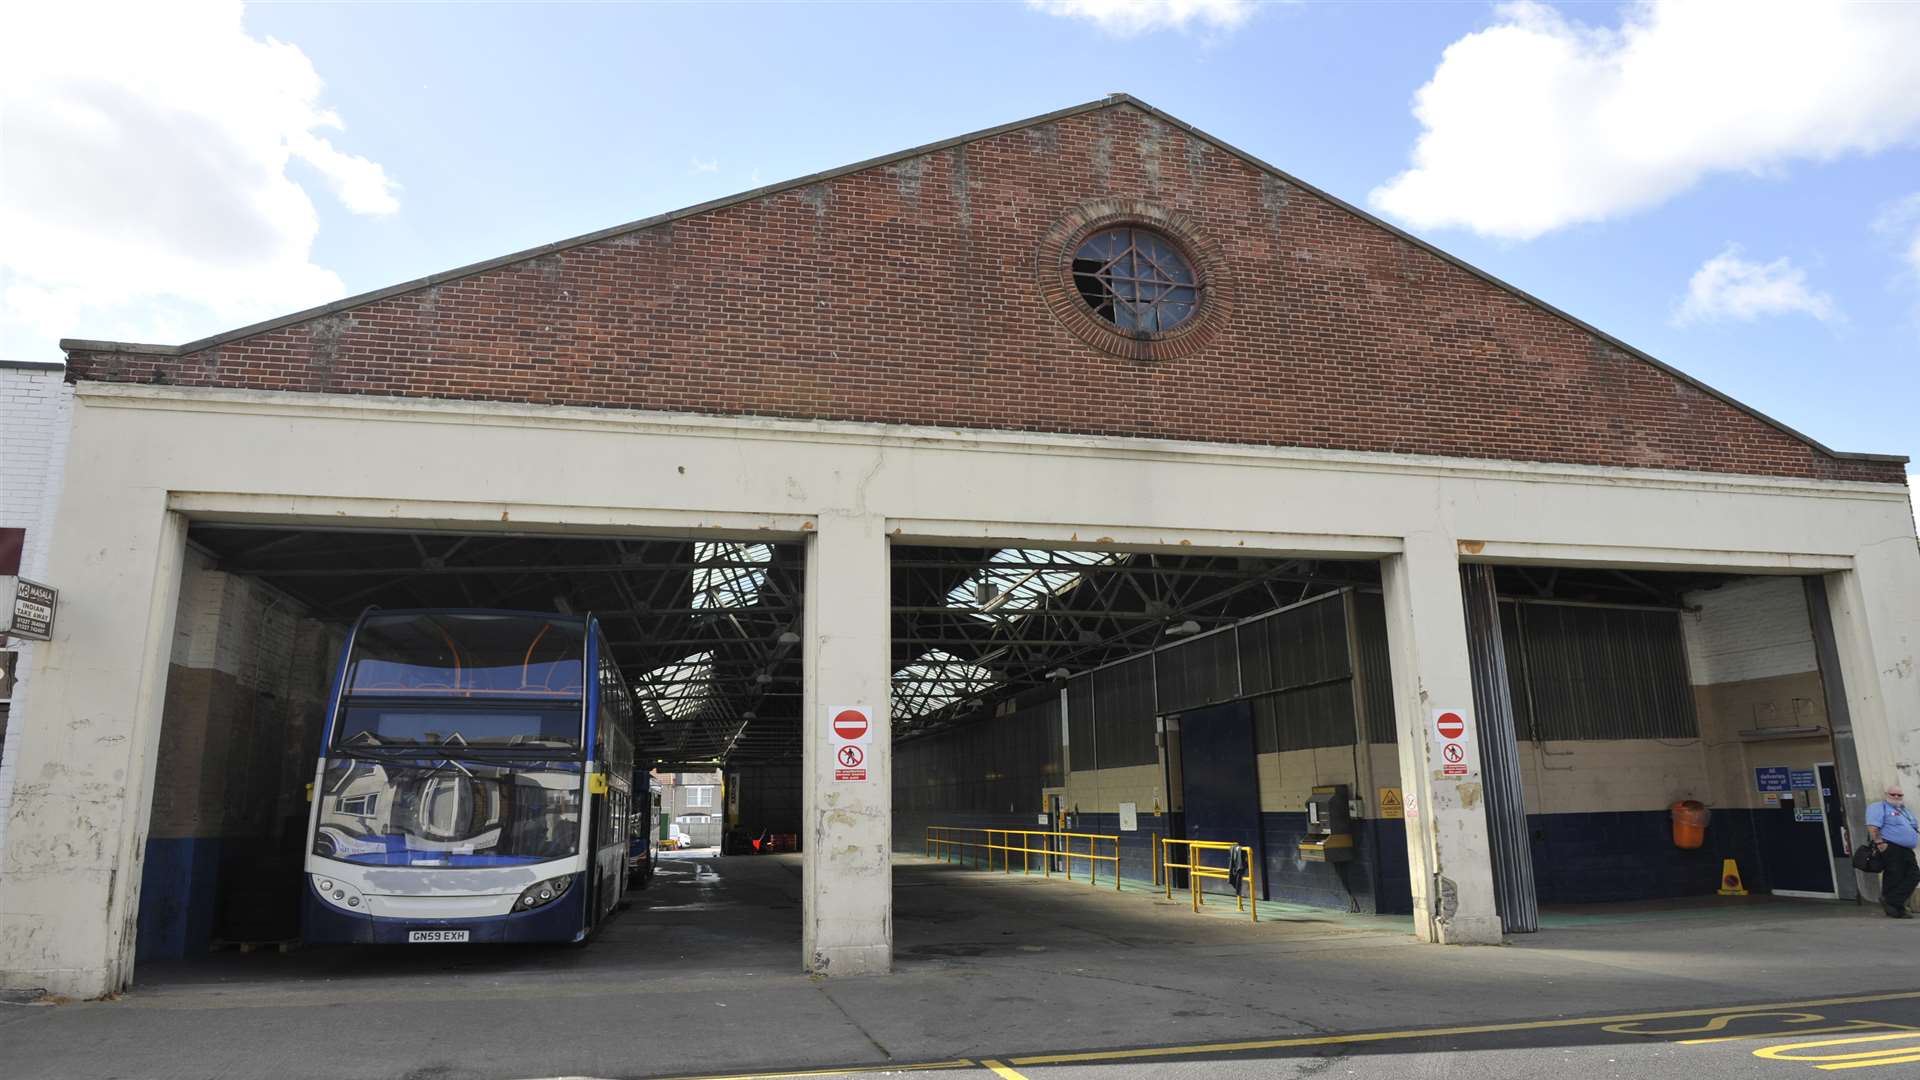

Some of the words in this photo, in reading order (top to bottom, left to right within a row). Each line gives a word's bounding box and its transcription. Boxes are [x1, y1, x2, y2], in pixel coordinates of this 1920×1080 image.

[30, 586, 52, 601] MASALA
[17, 608, 31, 616] TAKE
[22, 603, 44, 613] INDIAN
[413, 932, 441, 940] GN59
[444, 932, 464, 940] EXH
